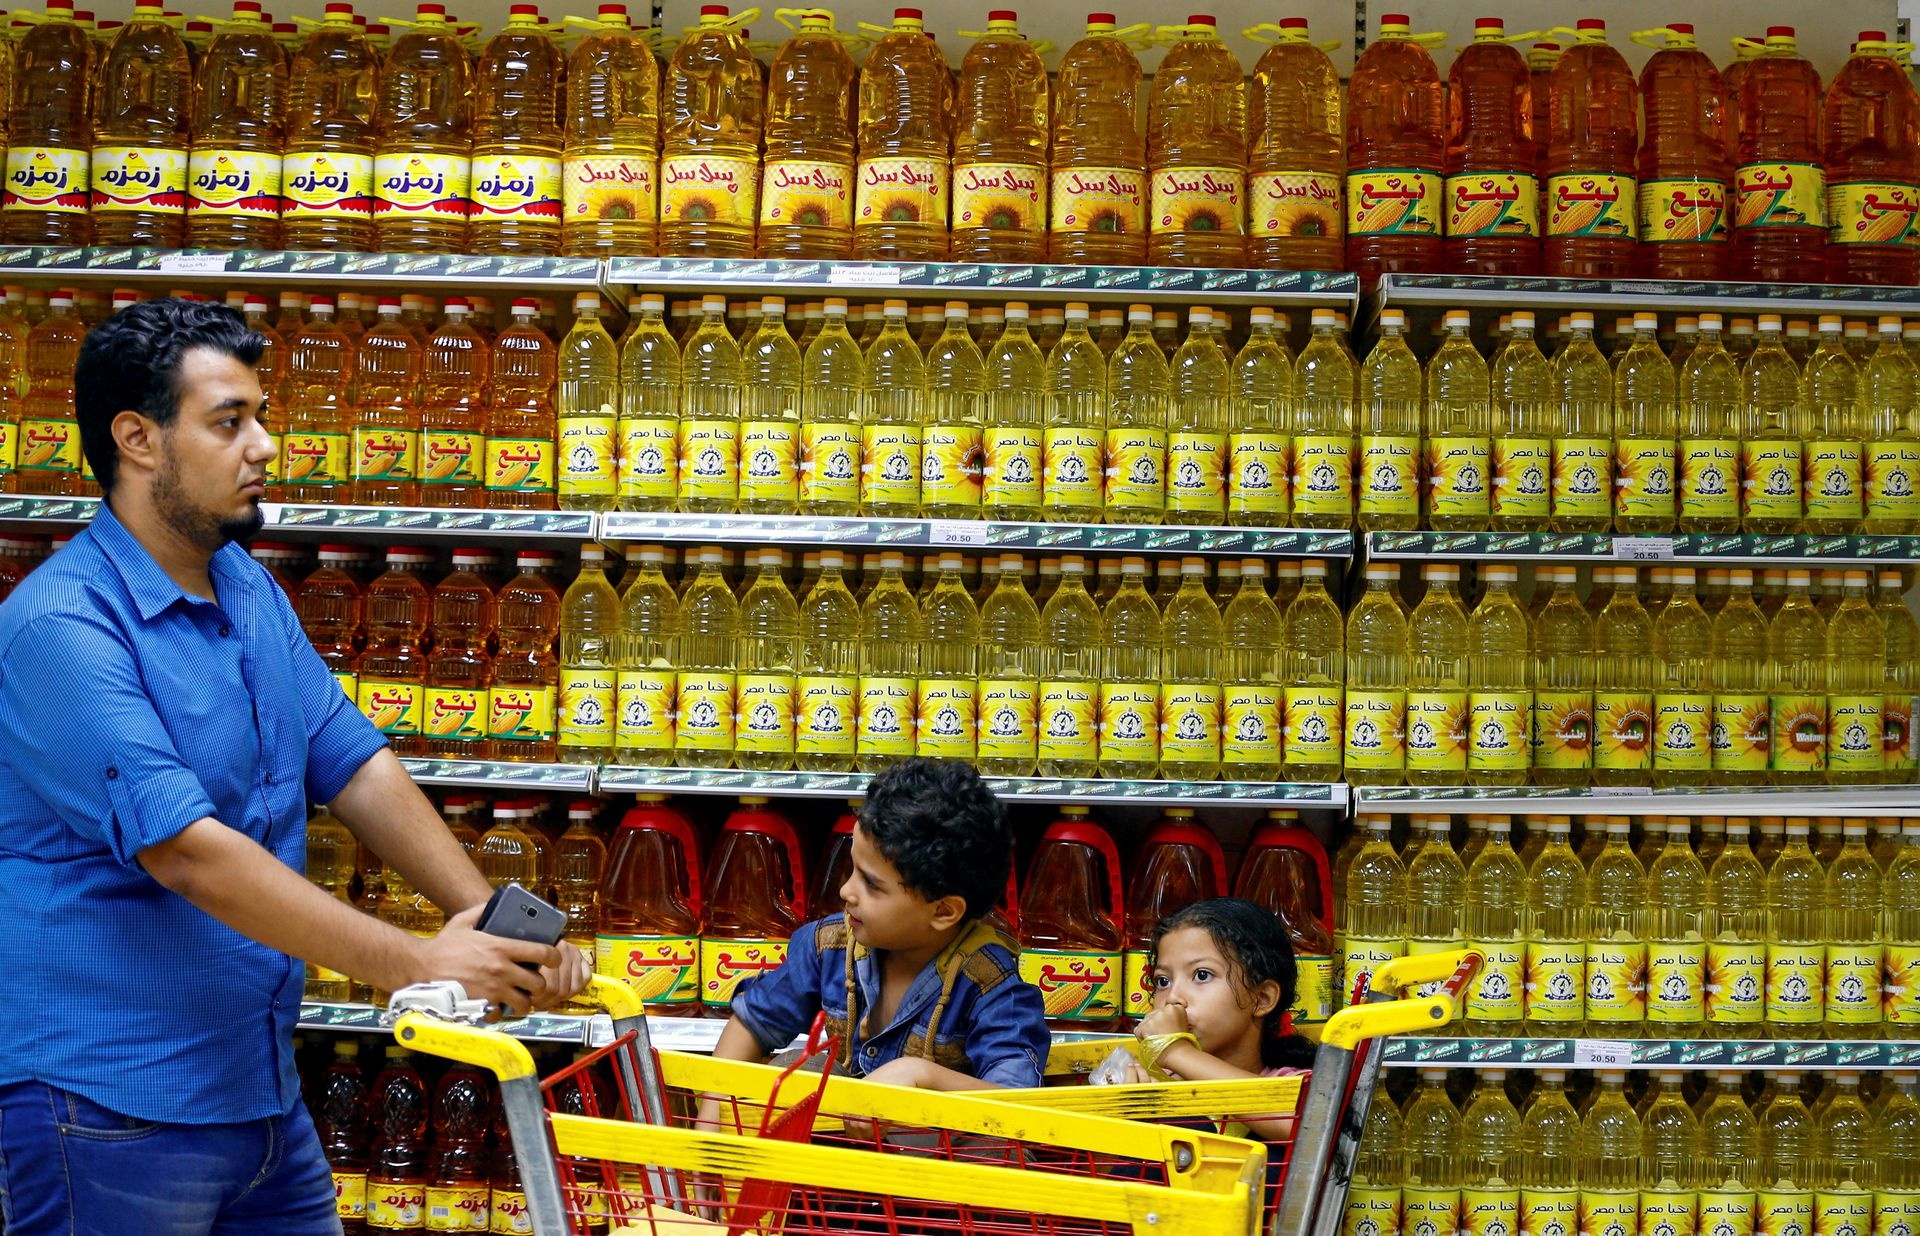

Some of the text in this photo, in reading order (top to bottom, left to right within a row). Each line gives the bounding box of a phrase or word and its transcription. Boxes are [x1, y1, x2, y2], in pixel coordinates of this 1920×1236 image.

[11, 166, 67, 188] زمزم
[100, 167, 160, 188] زمزم
[579, 163, 648, 184] سلاسل
[666, 162, 734, 184] سلاسل
[774, 168, 842, 190] سلاسل
[865, 164, 934, 185] سلاسل
[194, 170, 250, 191] زمزم
[289, 171, 348, 193] زمزم
[383, 172, 443, 194] زمزم
[476, 173, 535, 196] زمزم
[964, 170, 1035, 192] سلاسل
[1067, 174, 1136, 195] سلاسل
[1162, 173, 1234, 195] سلاسل
[1267, 179, 1336, 199] سلاسل
[107, 255, 130, 265] masria
[260, 259, 284, 269] masria
[571, 266, 595, 274] masria
[1008, 274, 1032, 284] masria
[1062, 276, 1086, 284] masria
[1169, 278, 1193, 287] masria
[1223, 279, 1247, 288] masria
[1331, 280, 1355, 289] masria
[563, 426, 607, 438] تحيا مصر
[628, 428, 673, 440] تحيا مصر
[689, 429, 734, 441] تحيا مصر
[744, 430, 790, 443] تحيا مصر
[1052, 436, 1098, 448] تحيا مصر
[1170, 441, 1215, 453] تحيا مصر
[1235, 441, 1281, 454] تحيا مصر
[1301, 444, 1347, 457] تحيا مصر
[1365, 444, 1410, 457] تحيا مصر
[1562, 446, 1608, 459] تحيا مصر
[1688, 448, 1734, 460] تحيا مصر
[1814, 449, 1858, 462] تحيا مصر
[1874, 450, 1919, 462] تحيا مصر
[898, 532, 922, 540] masria
[946, 534, 971, 542] 20.50
[1058, 536, 1082, 544] masria
[1220, 540, 1243, 548] masria
[1327, 542, 1351, 550] masria
[1400, 541, 1423, 550] masria
[1506, 542, 1530, 551] masria
[1772, 544, 1795, 553] masria
[1633, 552, 1659, 560] 20.50
[568, 679, 613, 690] تحيا مصر
[620, 680, 662, 692] تحيا مصر
[683, 681, 728, 693] تحيا مصر
[744, 684, 789, 696] تحيا مصر
[806, 685, 851, 697] تحيا مصر
[864, 686, 909, 698] تحيا مصر
[926, 688, 971, 700] تحيا مصر
[985, 688, 1030, 701] تحيا مصر
[1043, 690, 1088, 702] تحيا مصر
[1108, 692, 1154, 704] تحيا مصر
[1170, 692, 1215, 705] تحيا مصر
[1230, 694, 1275, 707] تحيا مصر
[1292, 696, 1338, 708] تحيا مصر
[1348, 700, 1391, 712] تحيا مصر
[1472, 701, 1517, 713] تحيا مصر
[1660, 702, 1704, 715] تحيا مصر
[1834, 704, 1879, 716] تحيا مصر
[1370, 950, 1392, 962] تحيا
[1653, 955, 1699, 966] تحيا مصر
[1774, 956, 1819, 967] تحيا مصر
[1830, 956, 1875, 968] تحيا مصر
[1436, 1049, 1460, 1059] masria
[1489, 1050, 1512, 1059] masria
[1542, 1050, 1565, 1060] masria
[1591, 1054, 1616, 1063] 20.50
[1648, 1052, 1671, 1061] masria
[1700, 1052, 1723, 1061] masria
[1752, 1052, 1776, 1061] masria
[1805, 1052, 1828, 1062] masria
[1348, 1200, 1392, 1211] تحيا مصر
[1407, 1201, 1450, 1212] تحيا مصر
[1668, 1203, 1688, 1215] تحيا
[1728, 1203, 1748, 1214] تحيا
[1824, 1205, 1868, 1216] تحيا مصر
